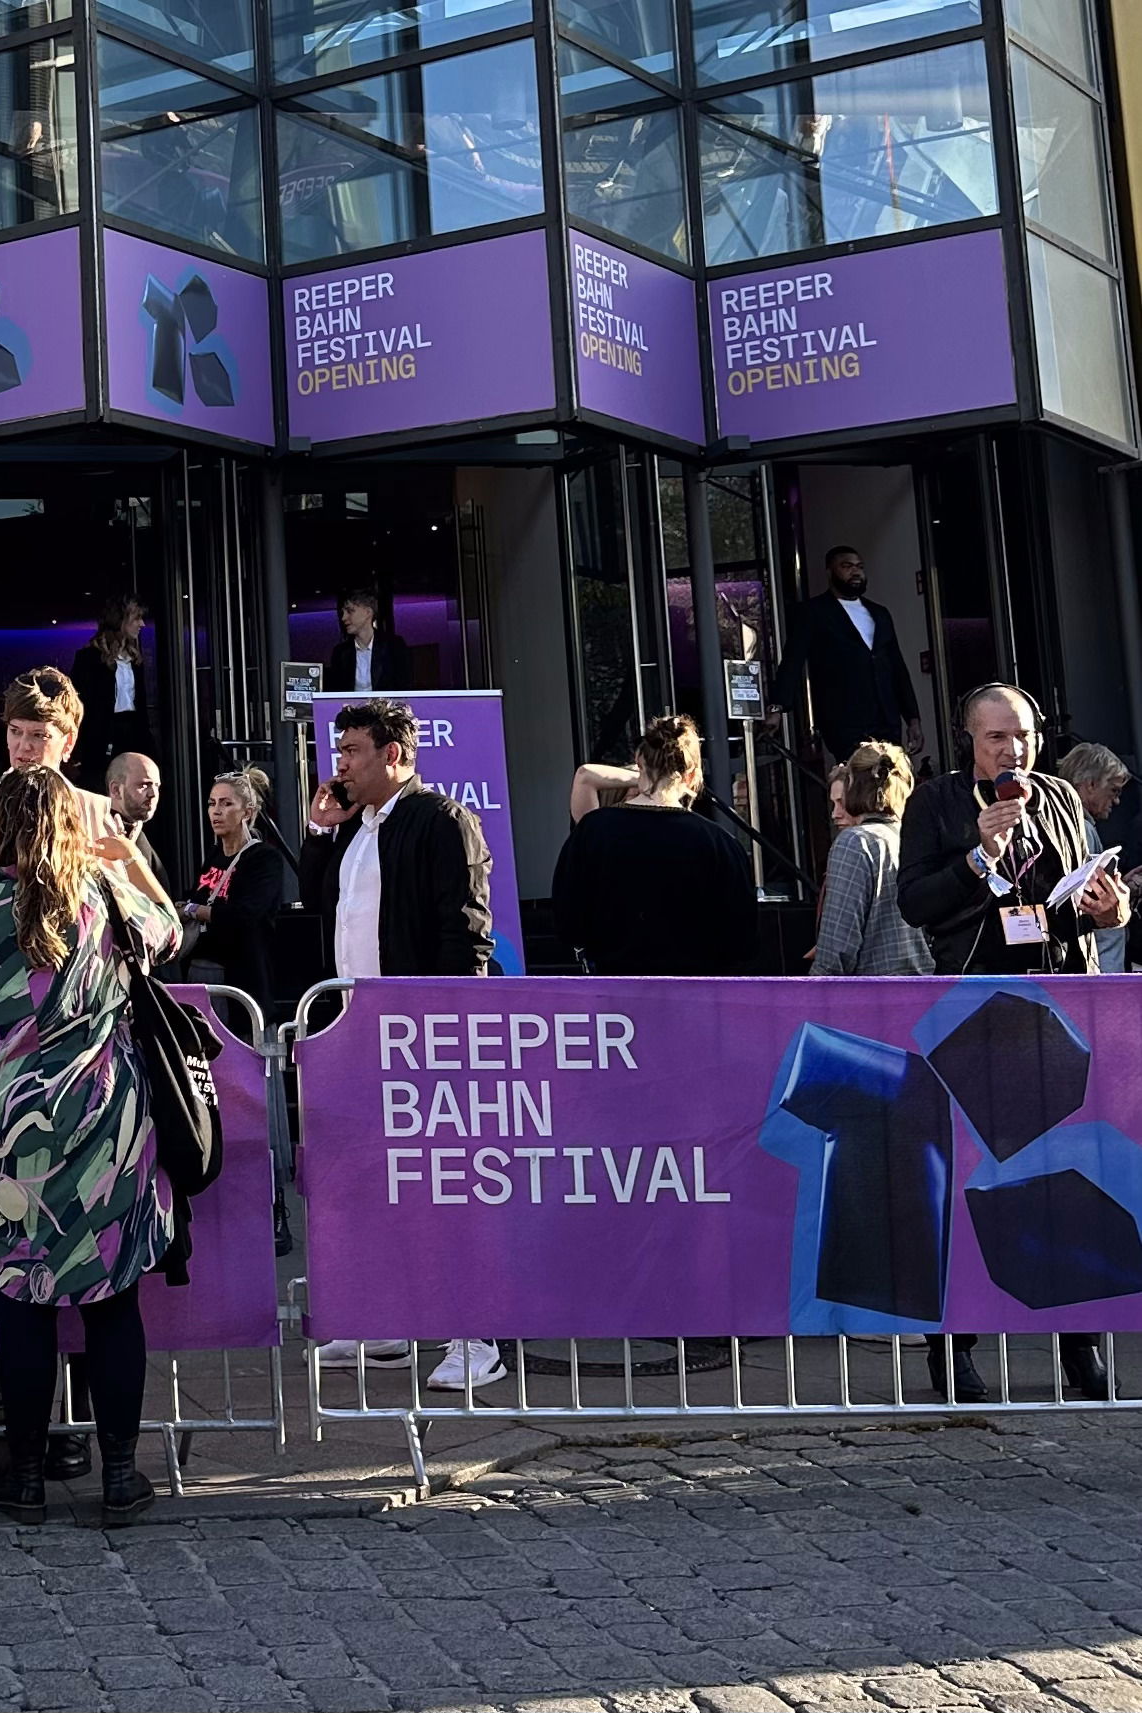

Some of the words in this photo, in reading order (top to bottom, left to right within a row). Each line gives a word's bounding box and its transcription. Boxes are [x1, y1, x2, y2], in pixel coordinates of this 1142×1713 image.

[575, 244, 629, 290] REEPER
[295, 273, 394, 313] REEPER
[577, 273, 613, 310] BAHN
[722, 273, 833, 314] REEPER
[296, 306, 360, 340] BAHN
[579, 302, 649, 351] FESTIVAL
[724, 306, 797, 341] BAHN
[298, 324, 431, 367] FESTIVAL
[581, 332, 643, 377] OPENING
[727, 323, 877, 368] FESTIVAL
[298, 354, 415, 394] OPENING
[727, 353, 859, 395] OPENING
[380, 1014, 637, 1069] REEPER
[383, 1081, 552, 1136] BAHN
[387, 1147, 730, 1204] FESTIVAL
